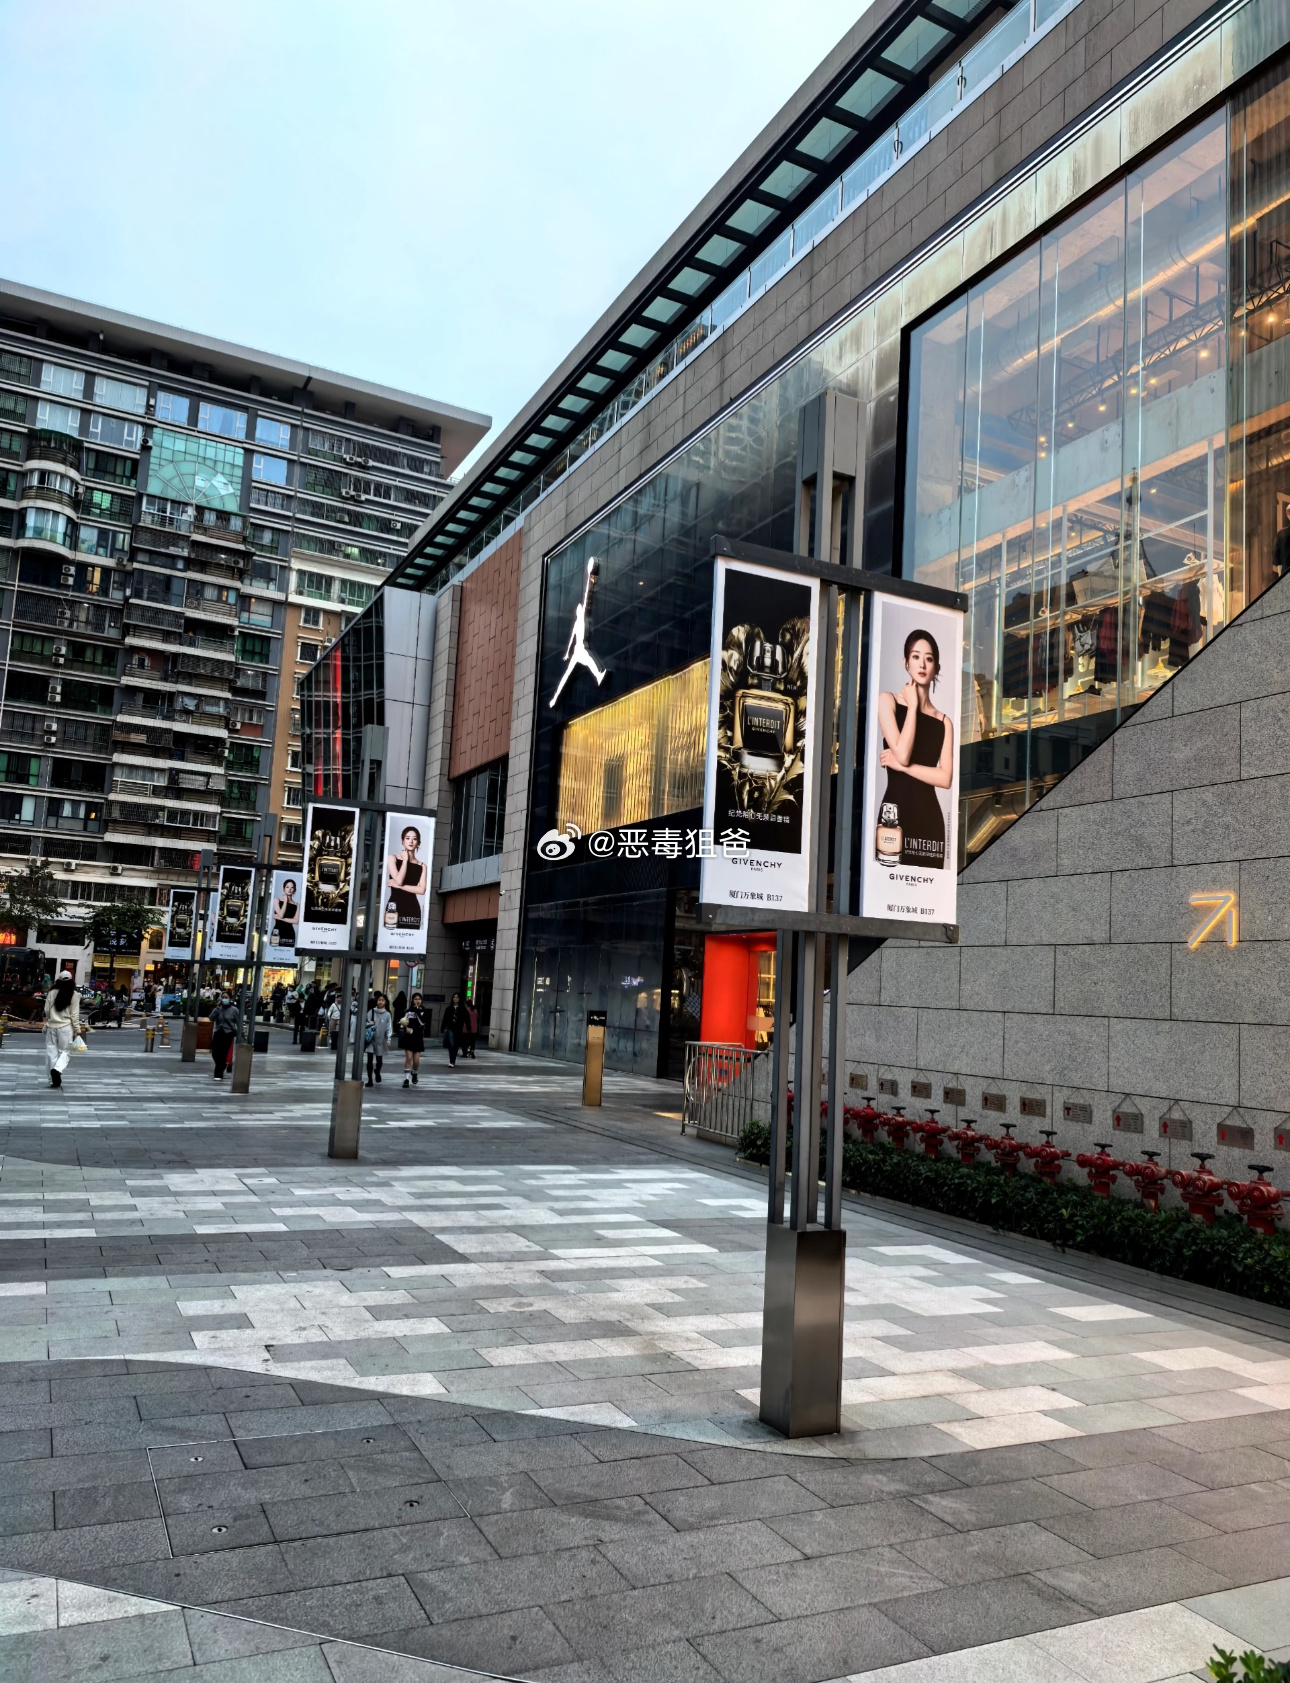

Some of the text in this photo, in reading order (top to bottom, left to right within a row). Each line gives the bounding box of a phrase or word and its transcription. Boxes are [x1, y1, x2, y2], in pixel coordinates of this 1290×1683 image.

[747, 716, 781, 730] L'INTERDIT
[904, 837, 944, 853] L'INTERDIT
[731, 857, 783, 868] GIVENCHY
[889, 873, 935, 884] GIVENCHY
[729, 890, 783, 902] 厦门万象城 B137
[920, 908, 935, 916] B137
